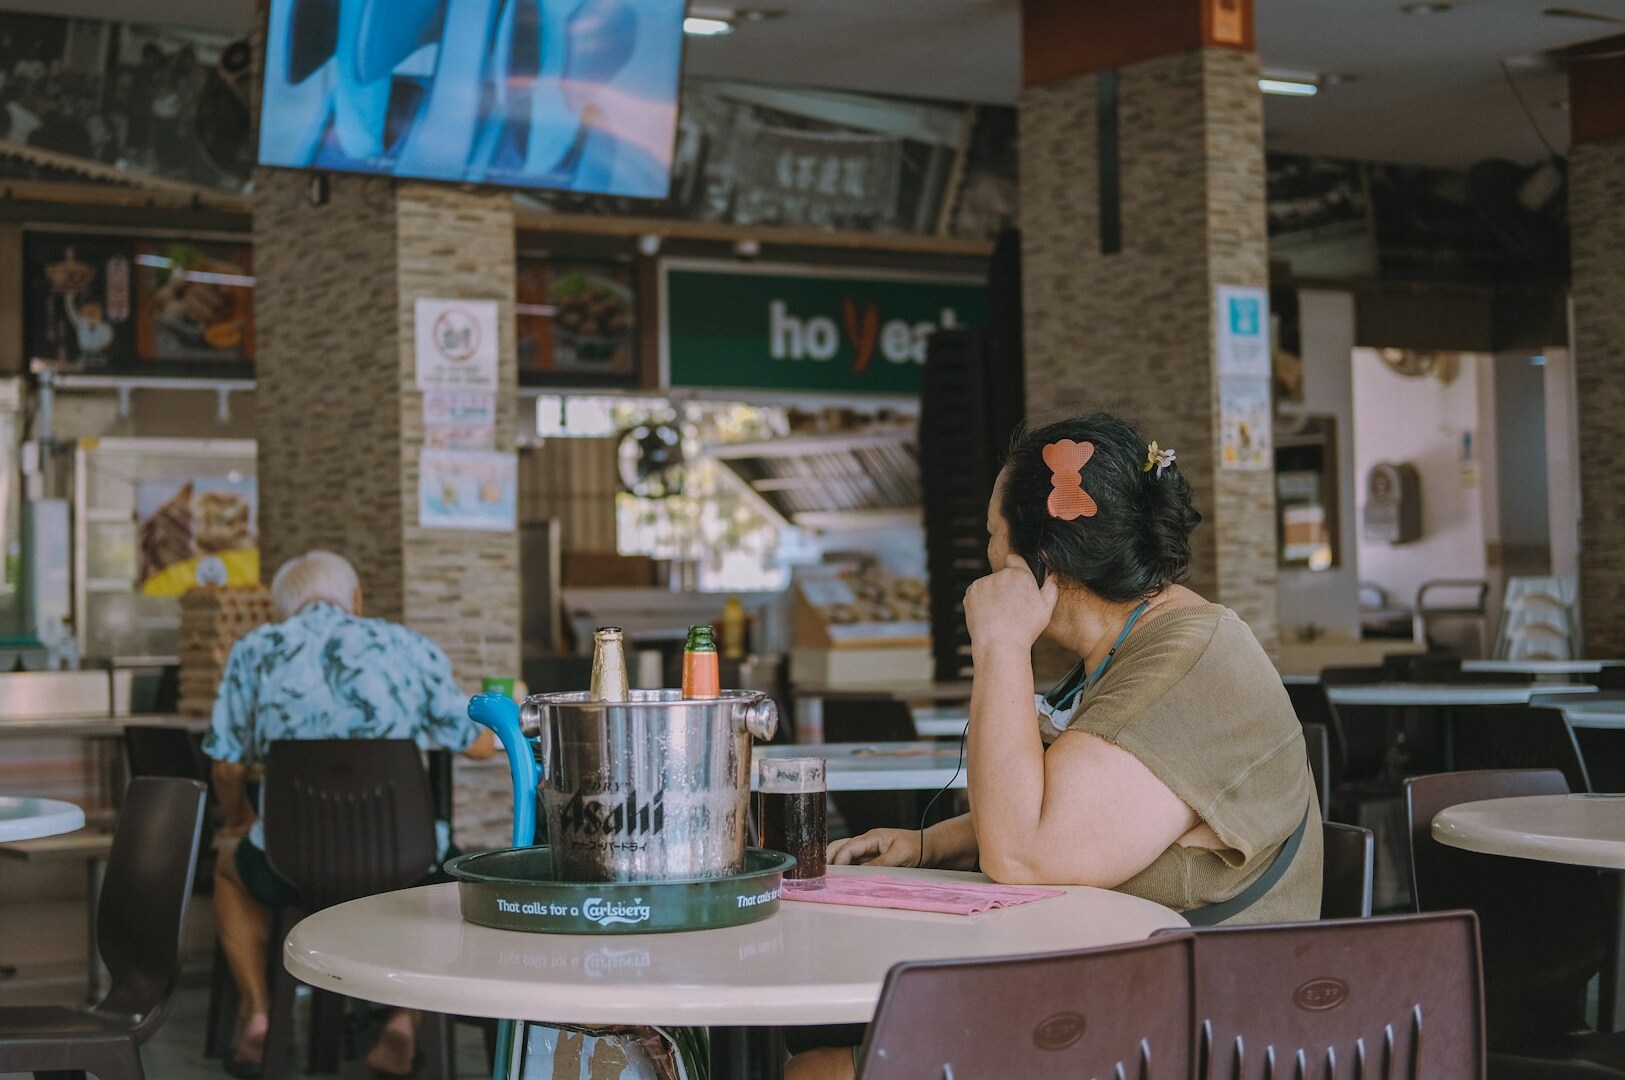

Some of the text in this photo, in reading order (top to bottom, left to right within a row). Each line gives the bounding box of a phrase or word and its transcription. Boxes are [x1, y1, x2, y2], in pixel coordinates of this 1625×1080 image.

[769, 299, 968, 373] hoyea
[561, 788, 663, 836] Asahi
[497, 898, 650, 926] That calls for a Carlsberg
[736, 895, 756, 908] That
[757, 891, 771, 904] calls
